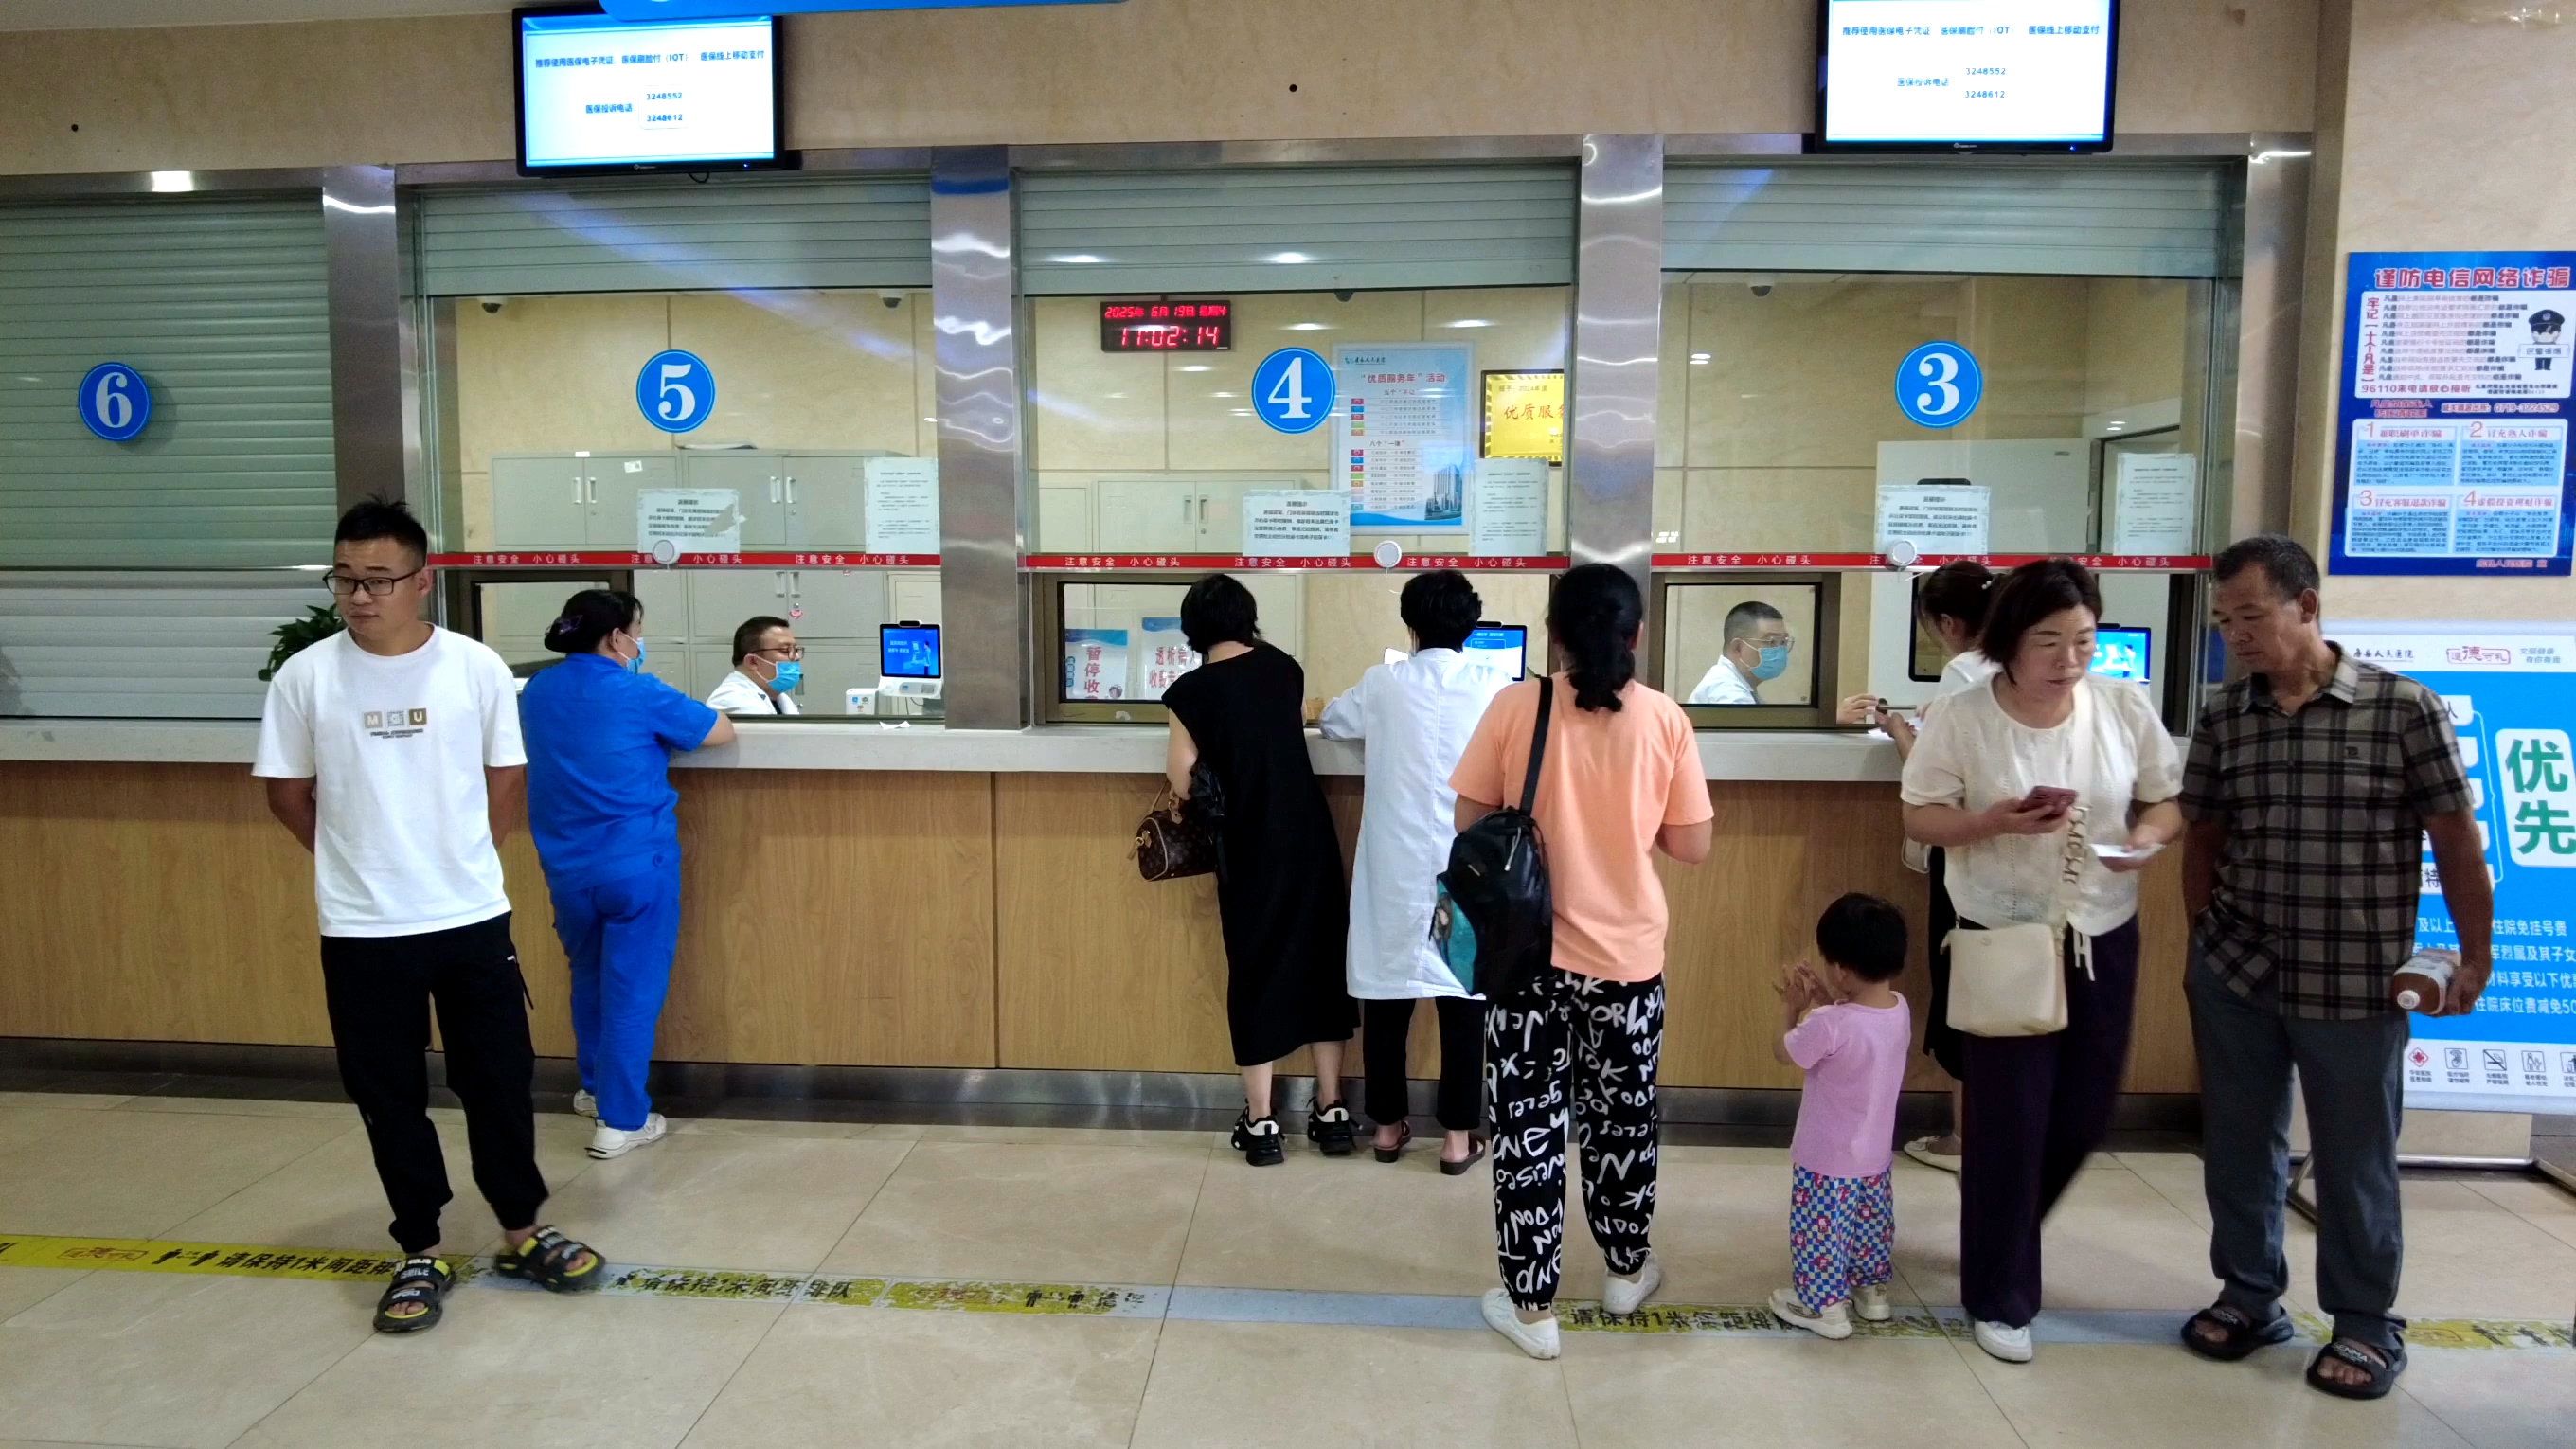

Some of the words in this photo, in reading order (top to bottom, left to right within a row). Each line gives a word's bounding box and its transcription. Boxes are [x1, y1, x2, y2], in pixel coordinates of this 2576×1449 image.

[2375, 268, 2570, 289] 谨防电信网络诈骗
[1267, 357, 1312, 419] 4
[1917, 352, 1959, 415] 3
[2361, 384, 2471, 394] 96110来电请放心接听
[95, 371, 133, 428] 6
[657, 363, 696, 421] 5
[2470, 421, 2483, 438] 2
[2360, 490, 2373, 507] 3
[2464, 491, 2477, 506] 4
[474, 555, 519, 564] 注意安全
[532, 555, 580, 564] 小心碰头
[693, 555, 742, 565] 小心碰头
[796, 554, 845, 565] 注意安全
[860, 555, 909, 565] 小心碰头
[1064, 557, 1116, 566] 注意安全
[1130, 557, 1180, 567] 小心碰头
[1235, 558, 1285, 567] 注意安全
[1300, 558, 1351, 567] 小心碰头
[1407, 557, 1458, 567] 注意安全
[1474, 558, 1526, 567] 小心碰头
[1688, 555, 1741, 565] 注意安全
[1757, 555, 1811, 565] 小心碰头
[2118, 557, 2170, 566] 小心碰头
[1149, 671, 1181, 689] 收费专
[2505, 739, 2576, 854] 优先
